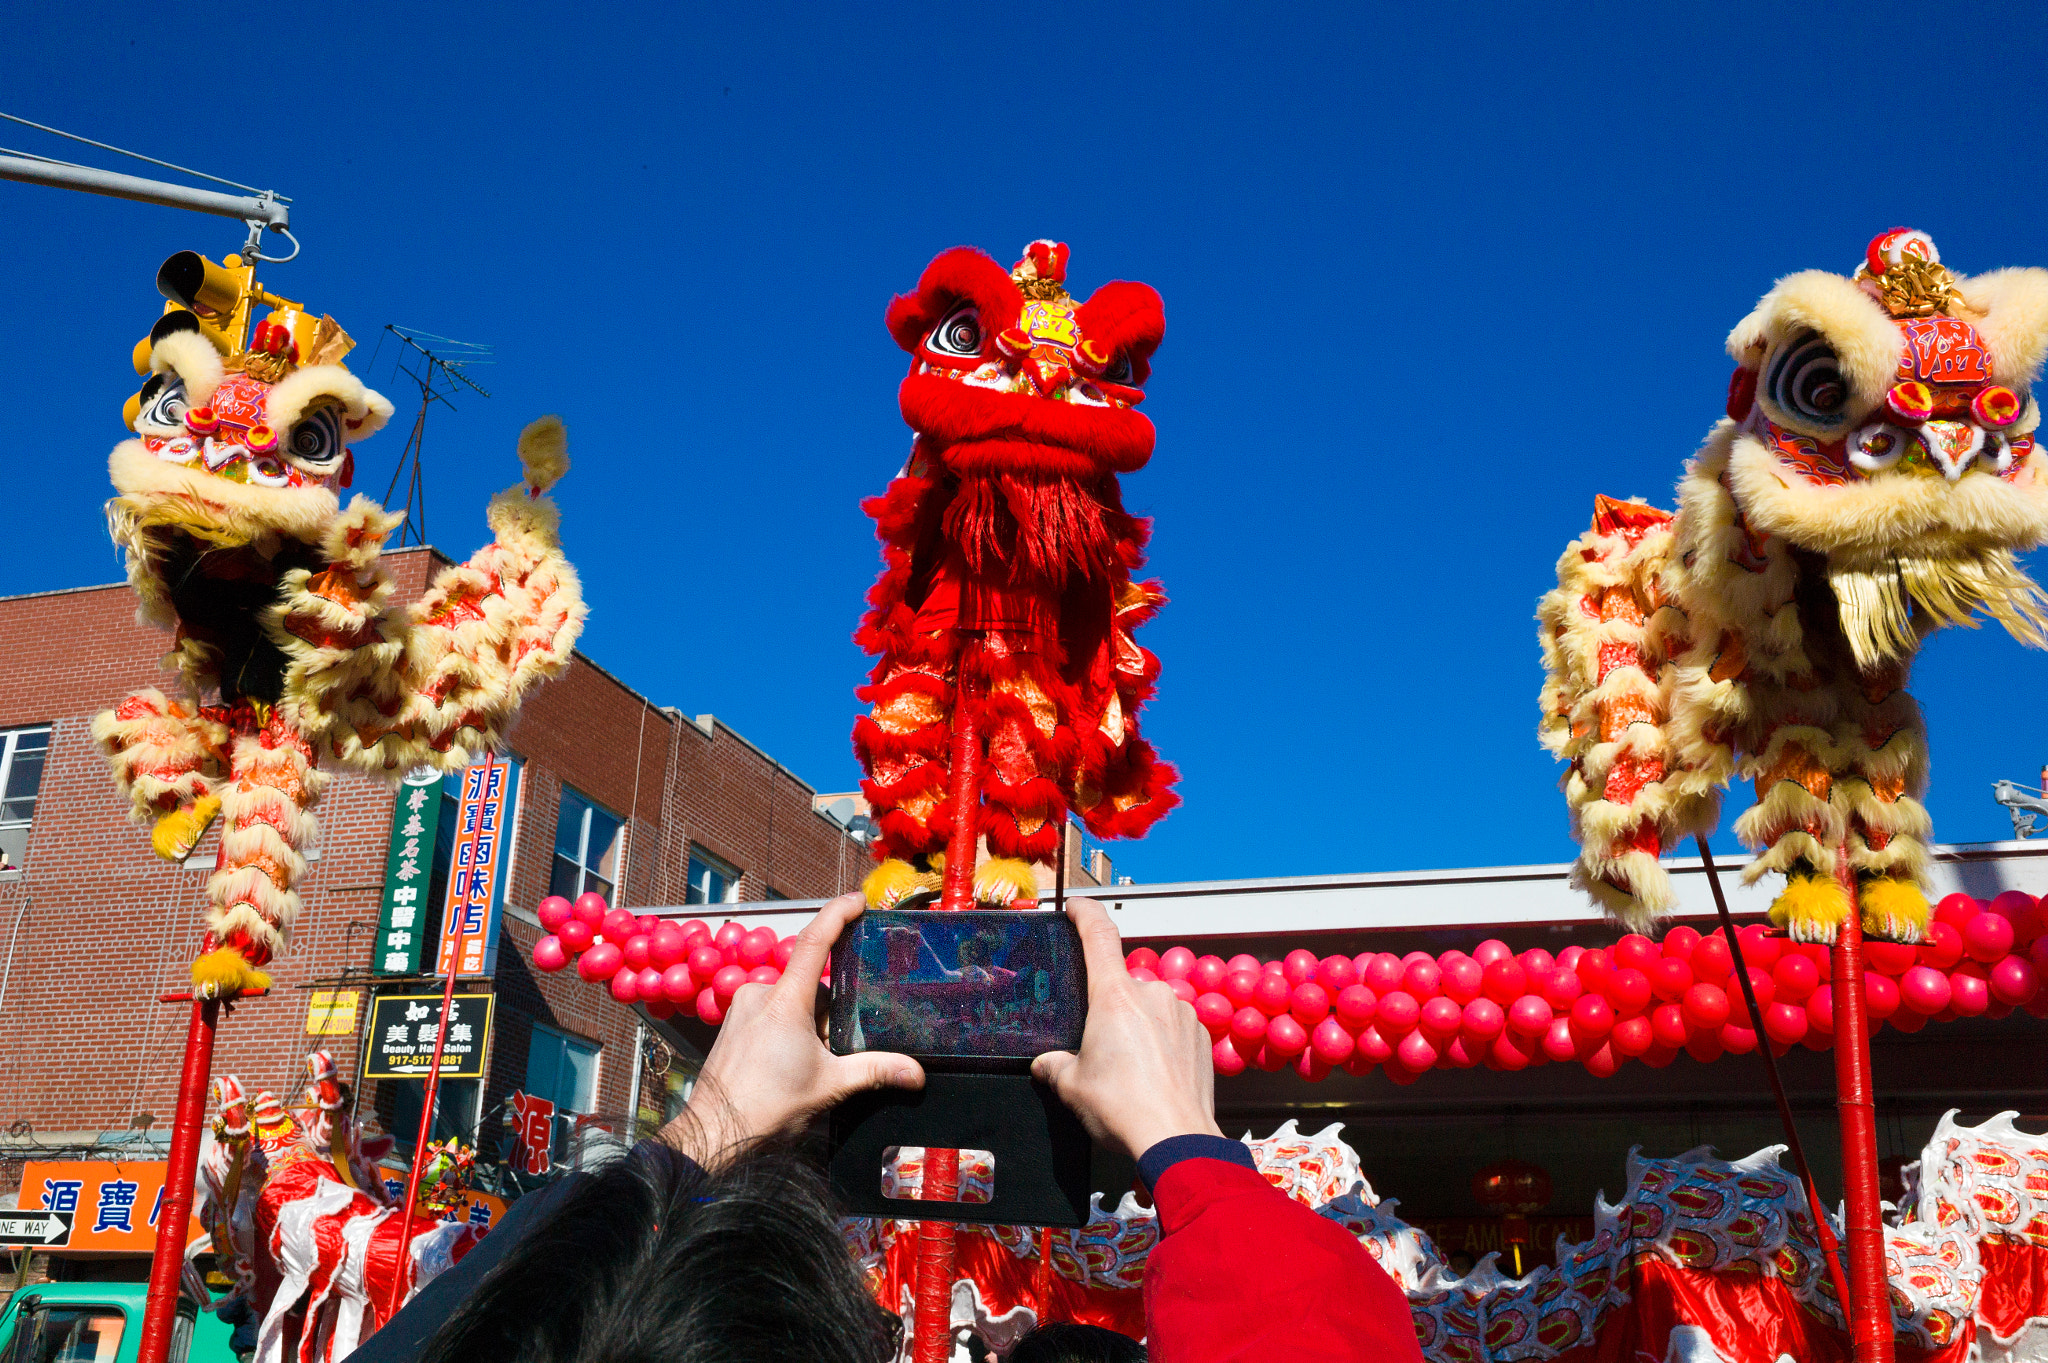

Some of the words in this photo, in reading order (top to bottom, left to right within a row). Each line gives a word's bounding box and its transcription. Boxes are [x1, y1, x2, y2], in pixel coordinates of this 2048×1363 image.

[382, 1044, 416, 1055] Beauty
[418, 1043, 440, 1053] Hai
[442, 1043, 472, 1053] Salon
[388, 1055, 463, 1065] 917-517881
[508, 1089, 555, 1176] 源
[42, 1179, 164, 1232] 源寶
[0, 1221, 17, 1234] NE
[24, 1221, 49, 1235] WAY
